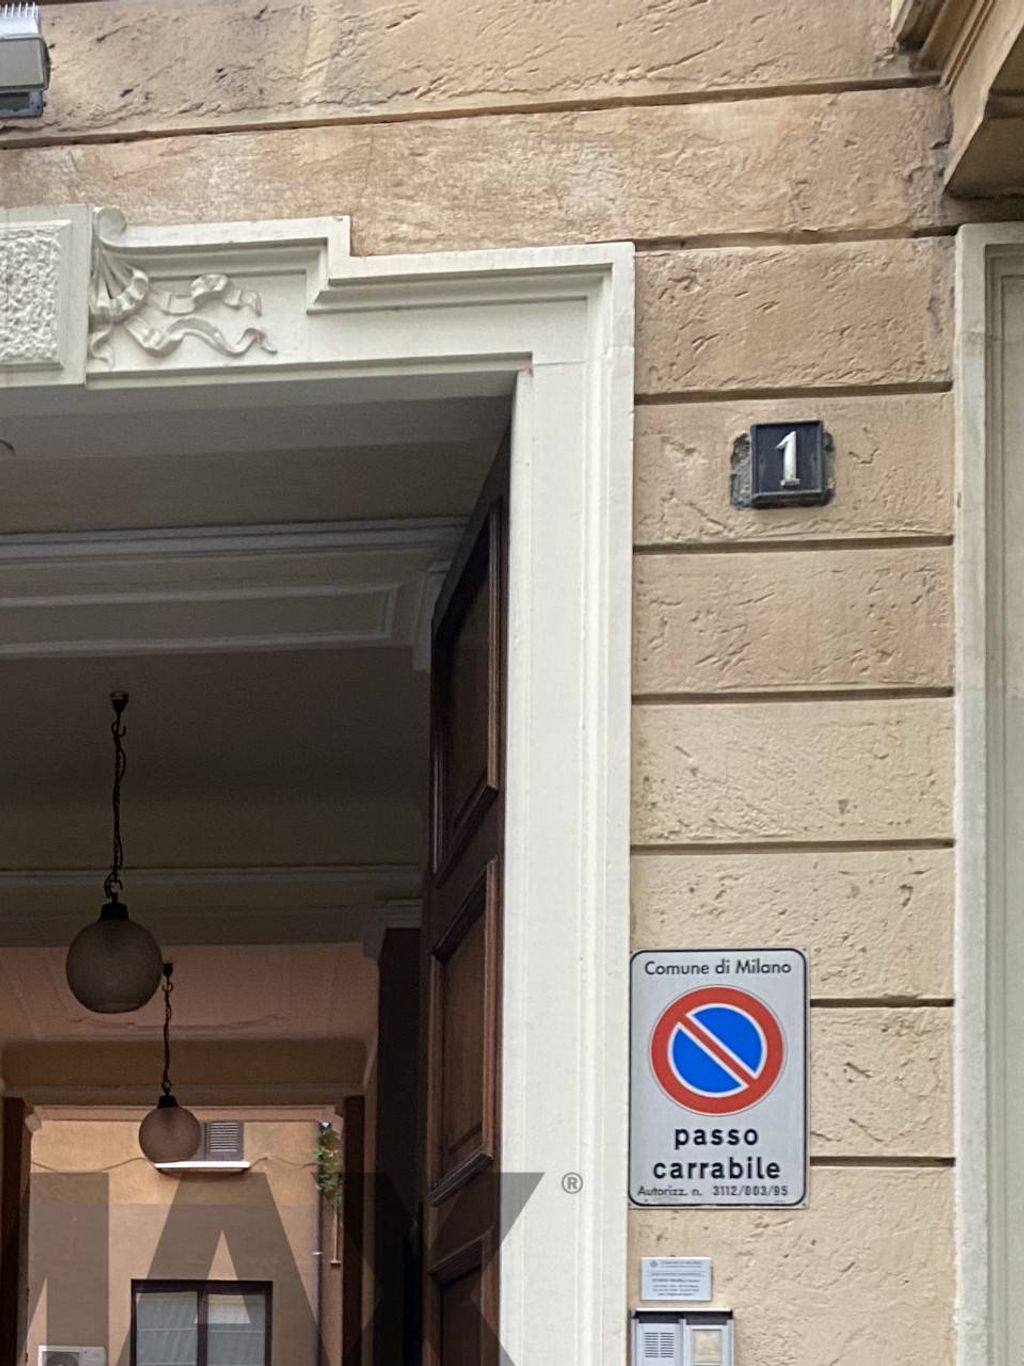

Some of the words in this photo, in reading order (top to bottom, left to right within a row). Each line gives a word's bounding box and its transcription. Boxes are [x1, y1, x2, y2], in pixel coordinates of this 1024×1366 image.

[775, 430, 800, 487] 1
[644, 960, 710, 976] Comune
[714, 958, 730, 975] di
[735, 957, 792, 975] Milano
[674, 1127, 759, 1151] passo
[652, 1156, 781, 1180] carrabile
[637, 1185, 689, 1197] Autorizz.
